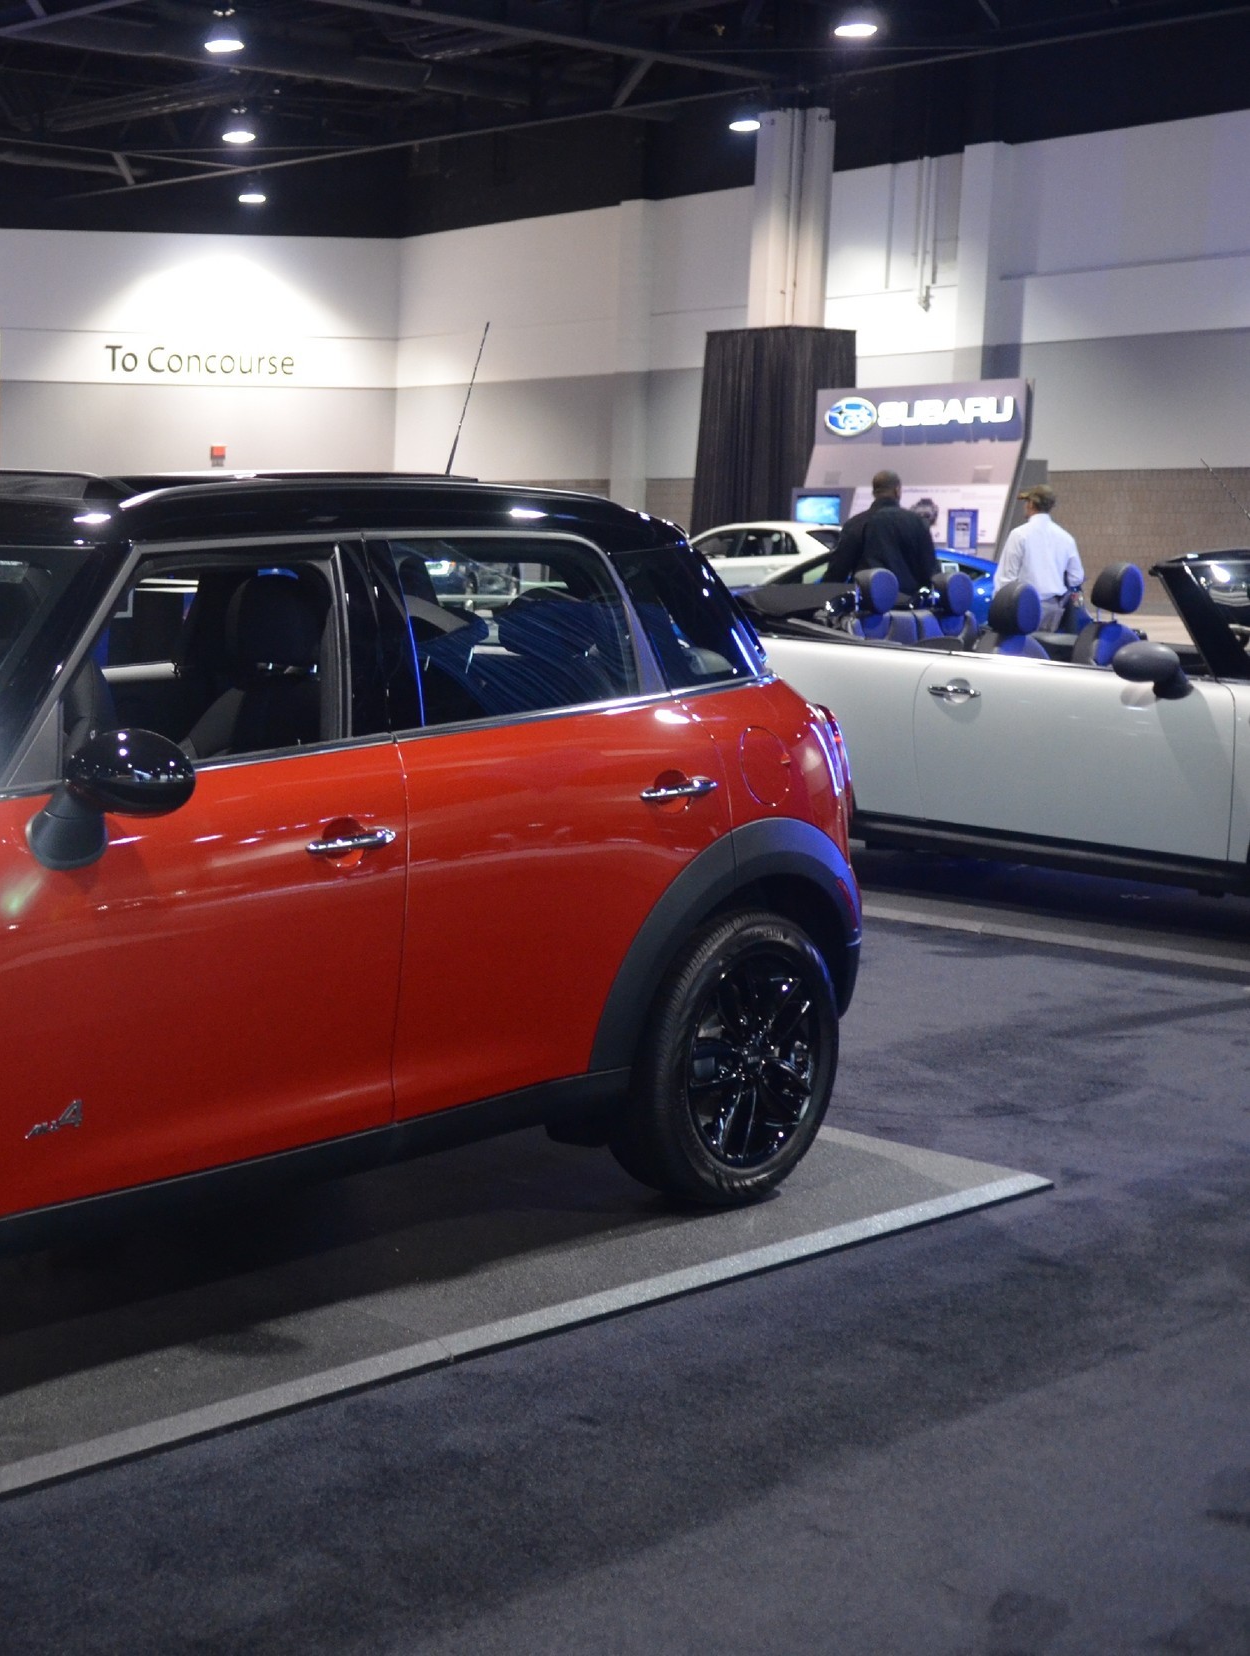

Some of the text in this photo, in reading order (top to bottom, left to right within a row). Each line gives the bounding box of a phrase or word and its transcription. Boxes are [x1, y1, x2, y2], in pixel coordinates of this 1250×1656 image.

[105, 344, 295, 375] To Concourse
[876, 395, 1014, 428] SUBARU
